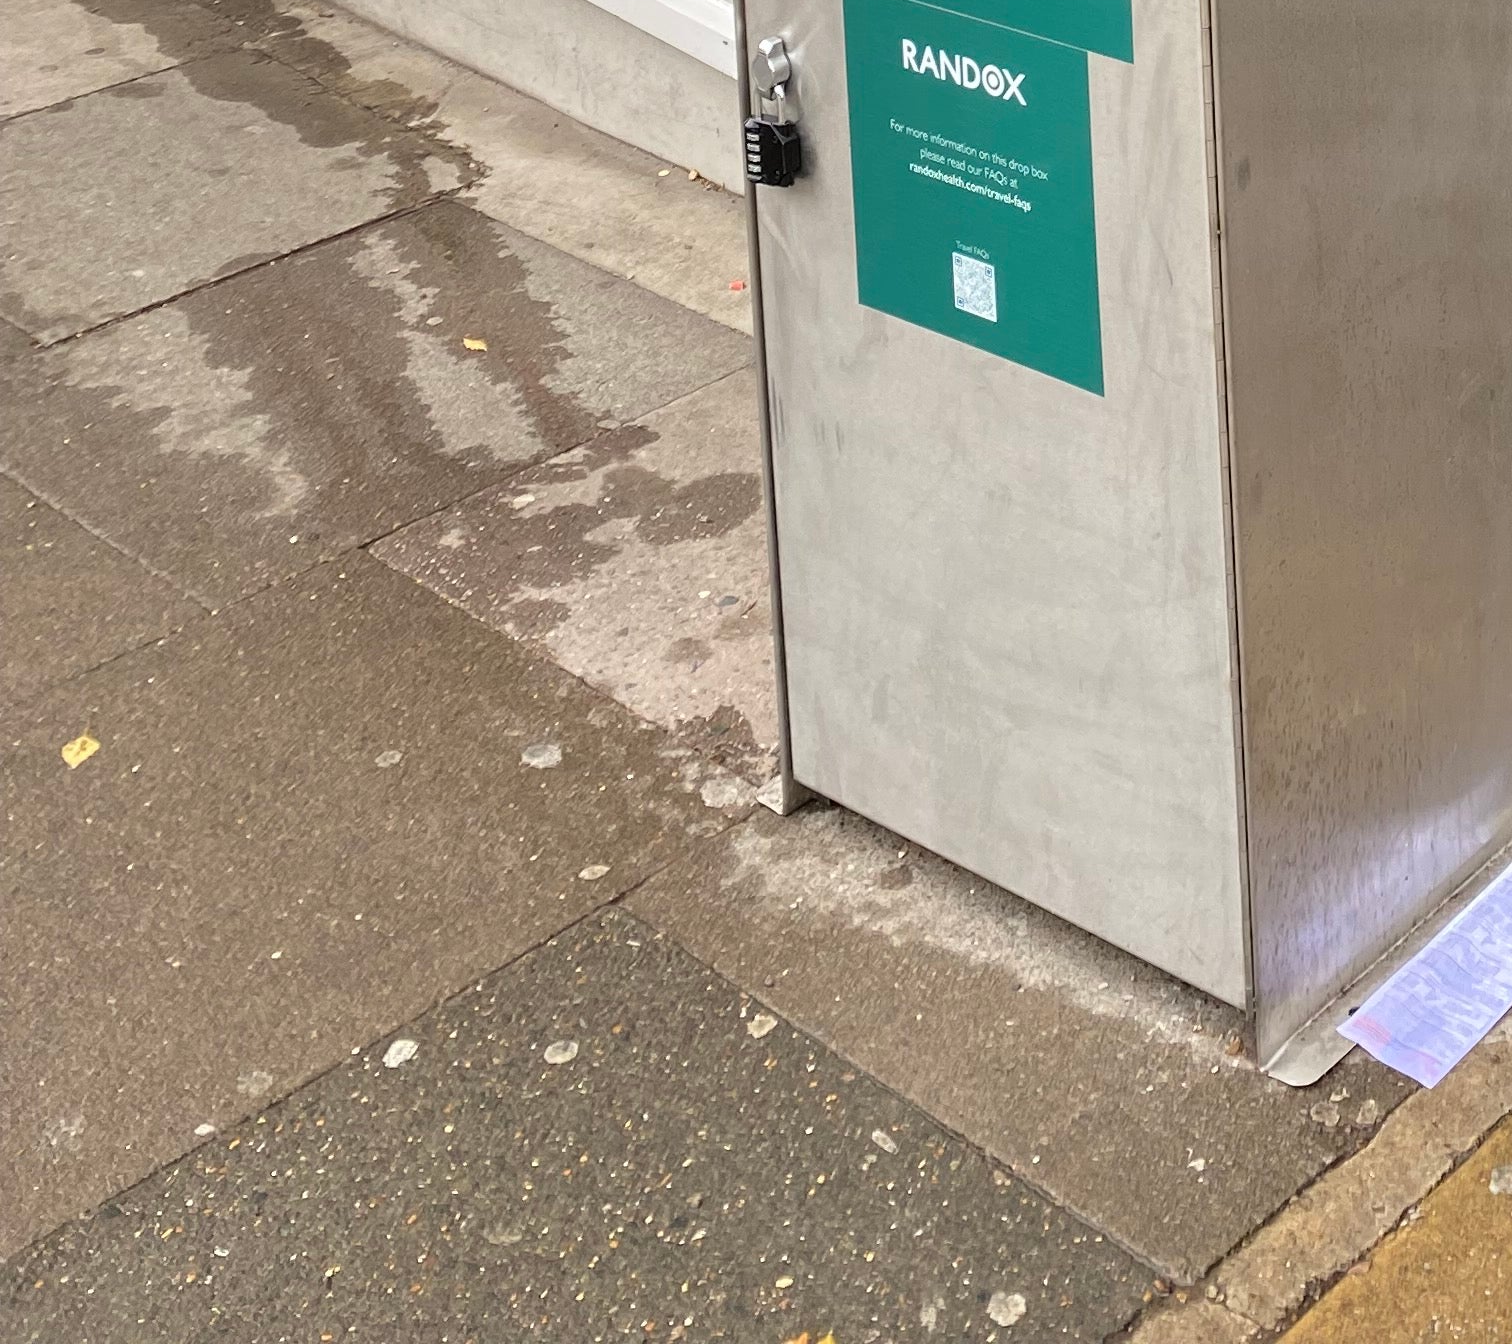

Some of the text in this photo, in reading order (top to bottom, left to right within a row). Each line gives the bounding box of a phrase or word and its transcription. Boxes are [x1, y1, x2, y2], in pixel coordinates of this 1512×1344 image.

[902, 37, 1027, 106] RANDOX
[890, 119, 1049, 181] For more information on this drop box
[920, 148, 1019, 189] please read our FAQs at
[909, 161, 1032, 213] randoxhealth.com/travel-faqs
[973, 244, 990, 260] FAQs
